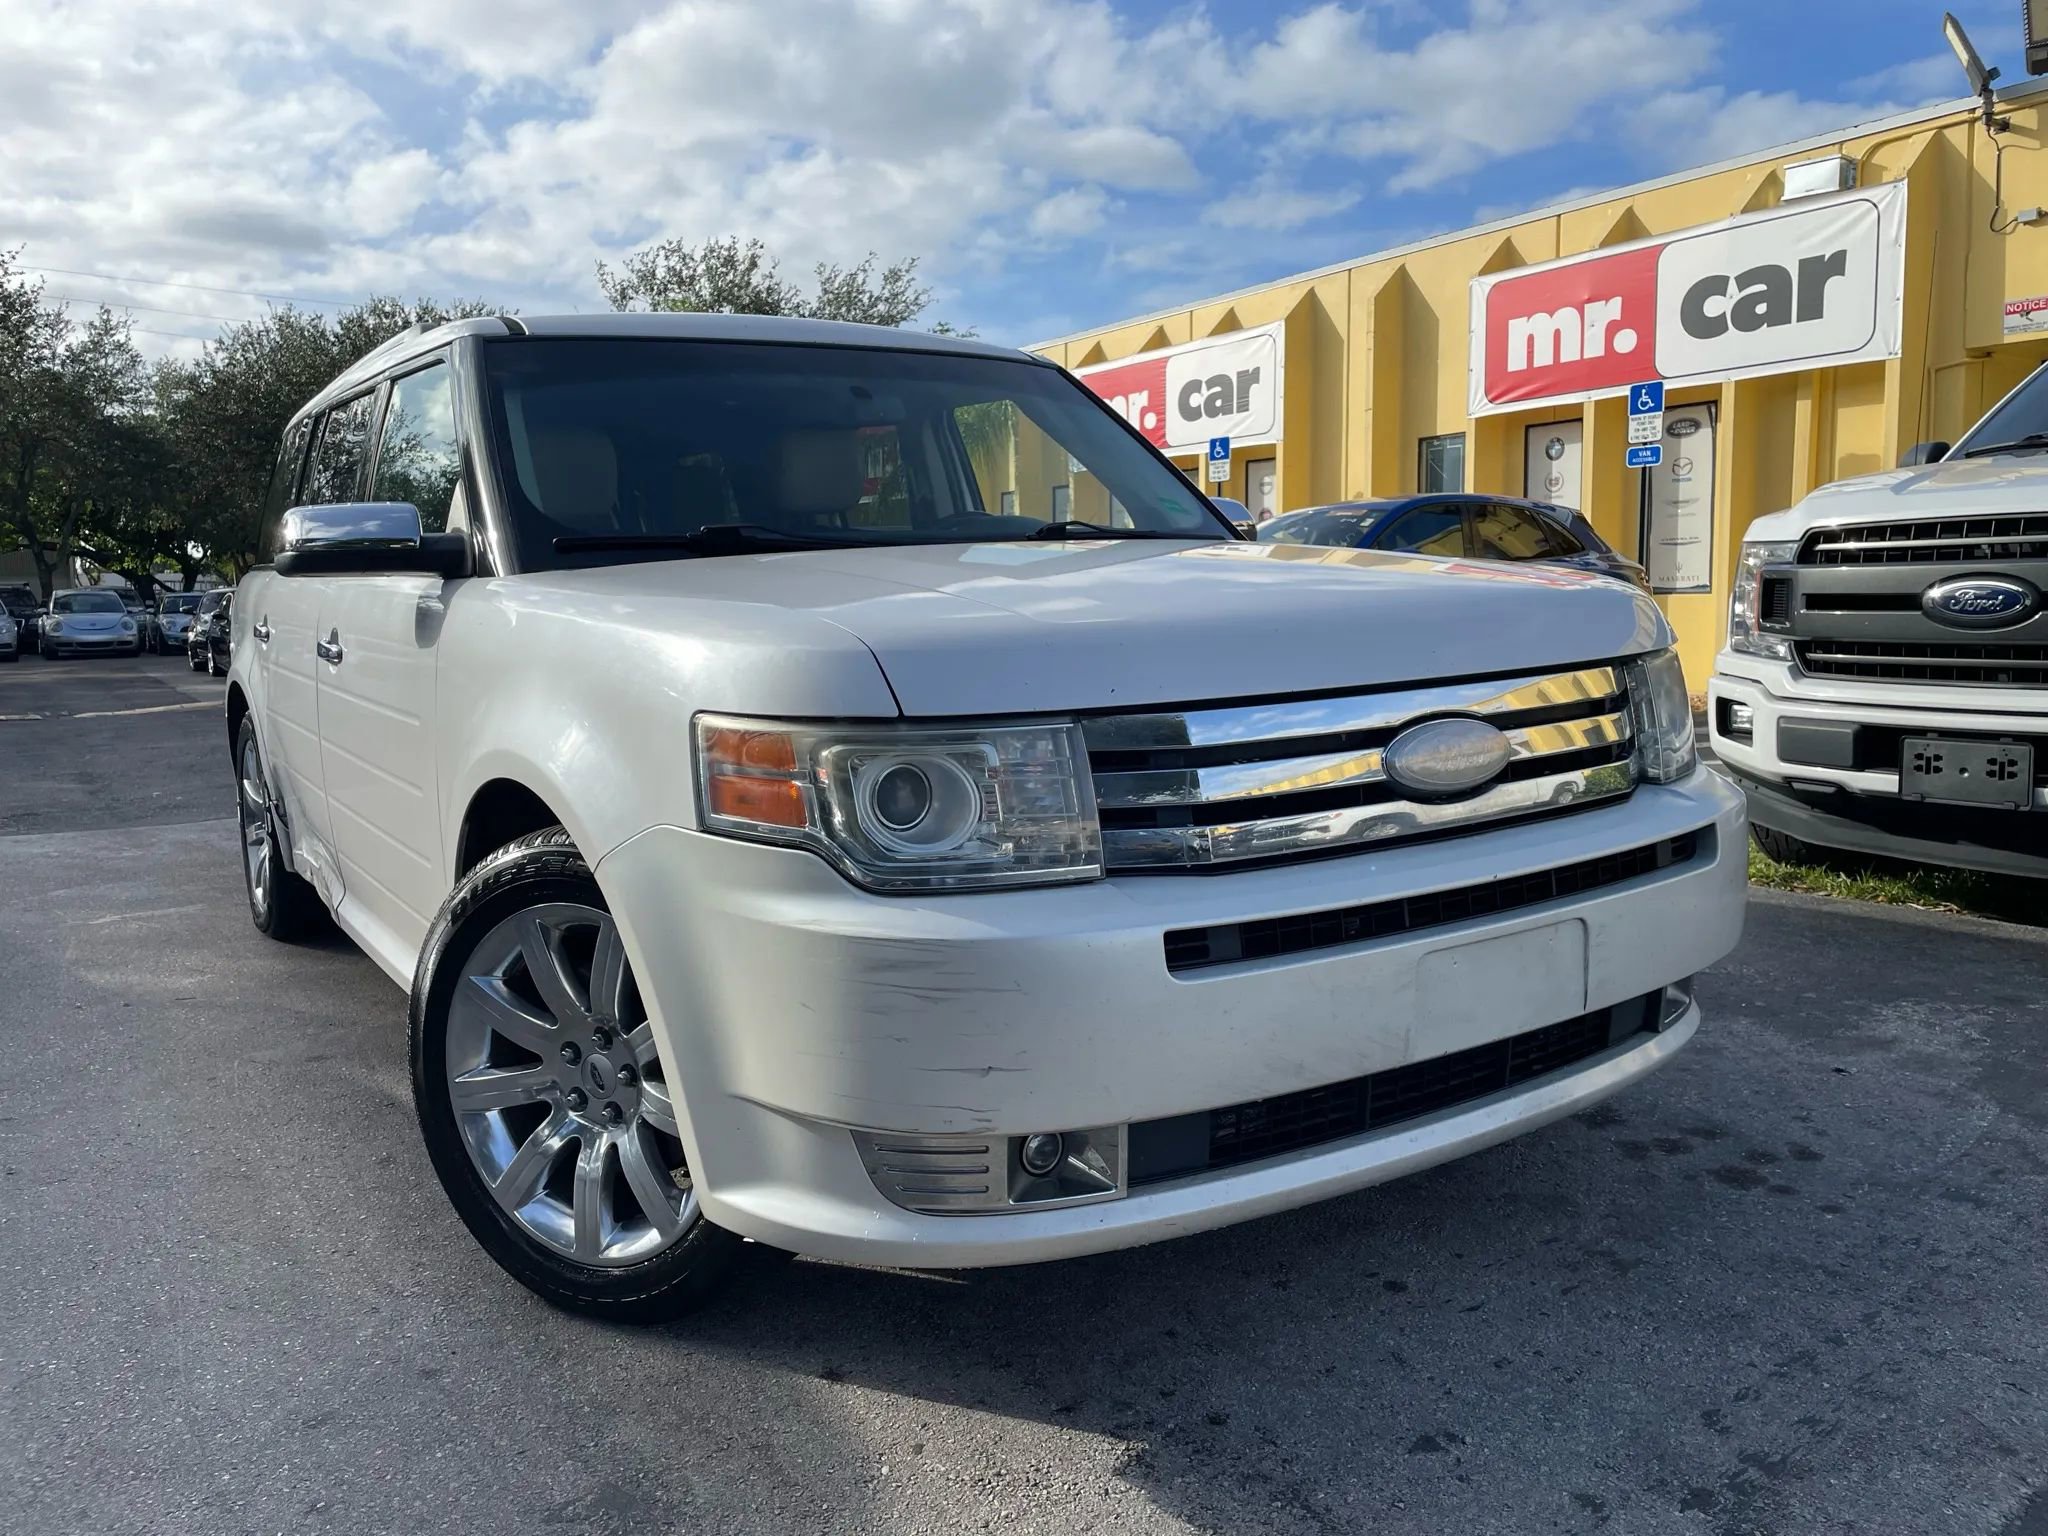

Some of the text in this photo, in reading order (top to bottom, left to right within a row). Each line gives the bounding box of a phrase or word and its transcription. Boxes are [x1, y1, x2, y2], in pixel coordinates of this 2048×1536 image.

[1507, 249, 1848, 373] mr. car
[2006, 299, 2047, 313] NOTICE
[1178, 366, 1260, 422] car
[1638, 449, 1651, 457] VAN
[1949, 589, 2005, 611] Ford
